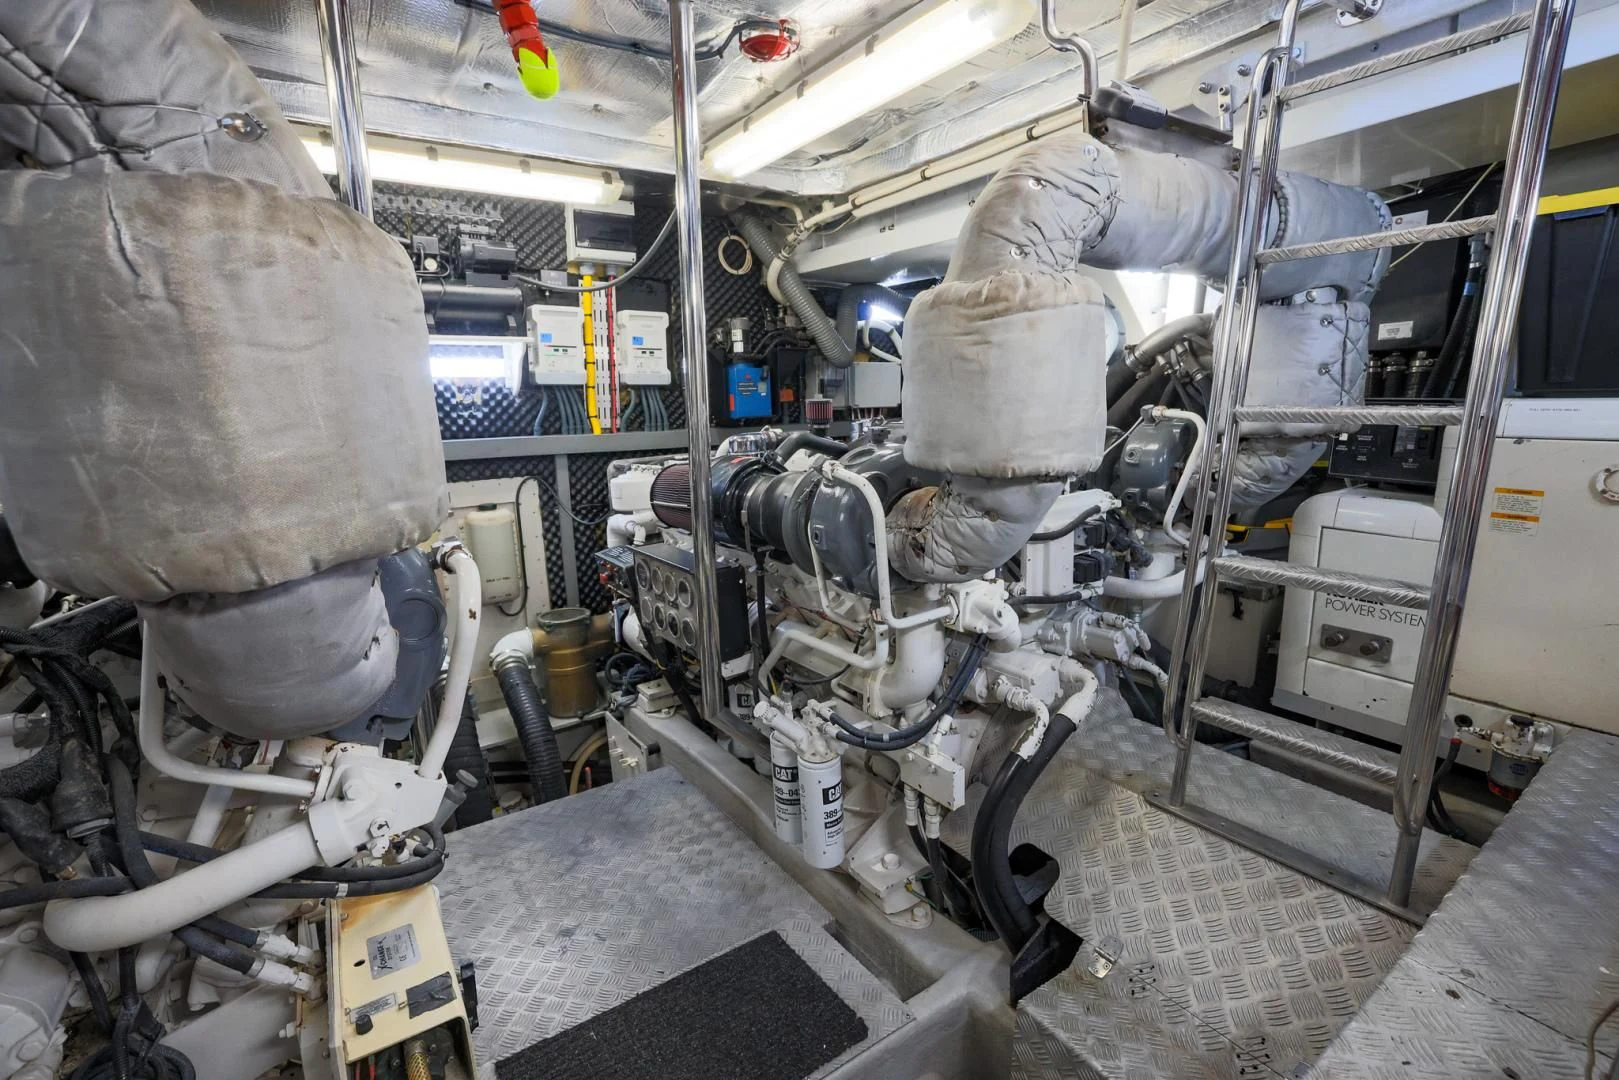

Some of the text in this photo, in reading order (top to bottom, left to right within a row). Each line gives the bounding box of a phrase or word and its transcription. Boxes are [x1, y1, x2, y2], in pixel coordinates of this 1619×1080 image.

[1325, 598, 1376, 618] POWER
[775, 767, 793, 781] CAT
[823, 808, 843, 820] 389-
